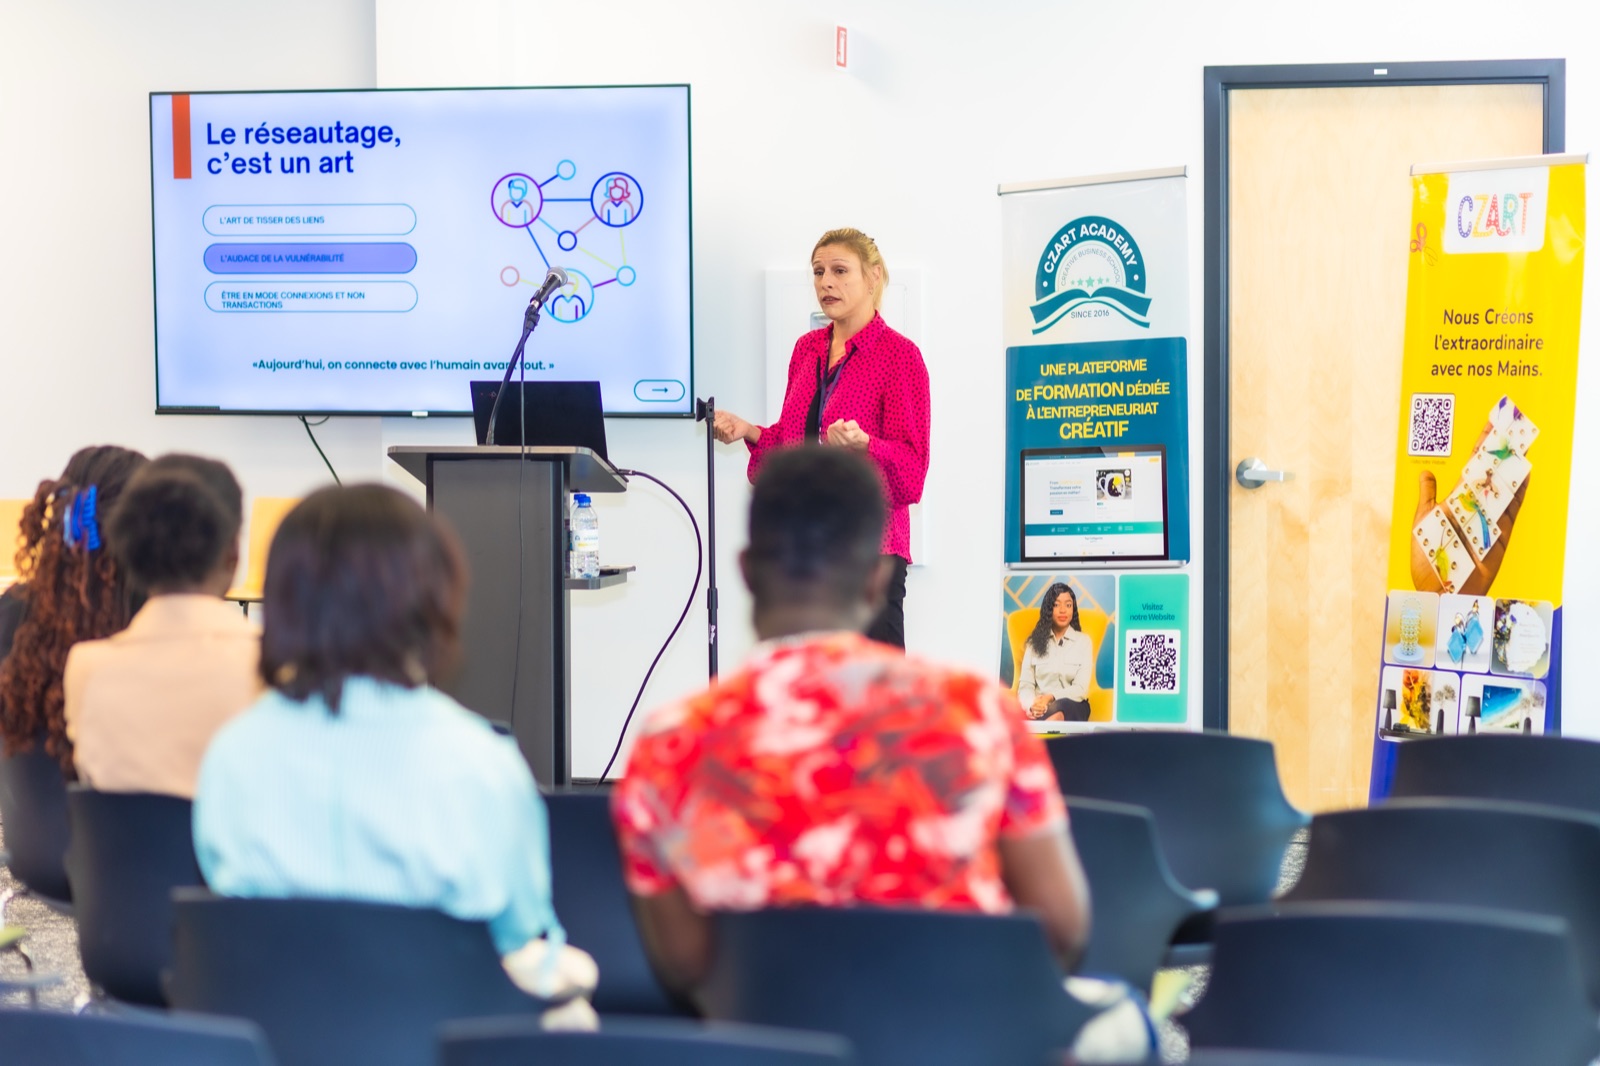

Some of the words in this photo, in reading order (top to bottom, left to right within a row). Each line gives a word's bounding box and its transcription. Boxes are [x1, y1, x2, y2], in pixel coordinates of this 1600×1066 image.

[206, 122, 236, 145] Le
[244, 121, 401, 149] réseautage,
[280, 156, 310, 174] un
[318, 150, 354, 174] art
[243, 216, 254, 225] DE
[256, 216, 284, 225] TISSER
[285, 216, 301, 224] DES
[302, 216, 325, 224] LIENS
[1457, 192, 1534, 239] CZART
[1044, 228, 1077, 274] CZART
[1079, 223, 1138, 266] ACADEMY
[261, 254, 272, 263] DE
[273, 254, 284, 263] LA
[285, 253, 345, 263] VULNÉRABILITÉ
[1060, 254, 1078, 287] CREATIVE
[1078, 248, 1107, 259] BUSINESS
[1106, 254, 1121, 285] SCHOOL
[221, 290, 241, 300] ÊTRE
[242, 291, 254, 300] EN
[255, 291, 279, 300] MODE
[280, 291, 334, 300] CONNEXIONS
[335, 291, 345, 300] ET
[347, 291, 365, 300] NON
[221, 301, 283, 309] TRANSACTIONS
[1070, 310, 1092, 319] SINCE
[1093, 309, 1110, 317] 2016
[1443, 309, 1480, 325] Nous
[1484, 306, 1534, 325] Créons
[327, 361, 342, 370] on
[344, 360, 397, 370] connecte
[399, 361, 427, 370] avec
[483, 360, 517, 370] avan
[1040, 362, 1067, 376] UNE
[1068, 359, 1147, 375] PLATEFORME
[1431, 363, 1463, 376] avec
[1467, 363, 1493, 376] nos
[1497, 360, 1543, 377] Mains.
[1016, 388, 1032, 401] DE
[1033, 382, 1124, 400] FORMATION
[1126, 379, 1170, 396] DÉDIÉE
[1026, 404, 1036, 420] À
[1059, 417, 1129, 440] CRÉATIF
[1141, 602, 1164, 611] Visitez
[1129, 613, 1148, 621] notre
[1148, 613, 1176, 621] Website
